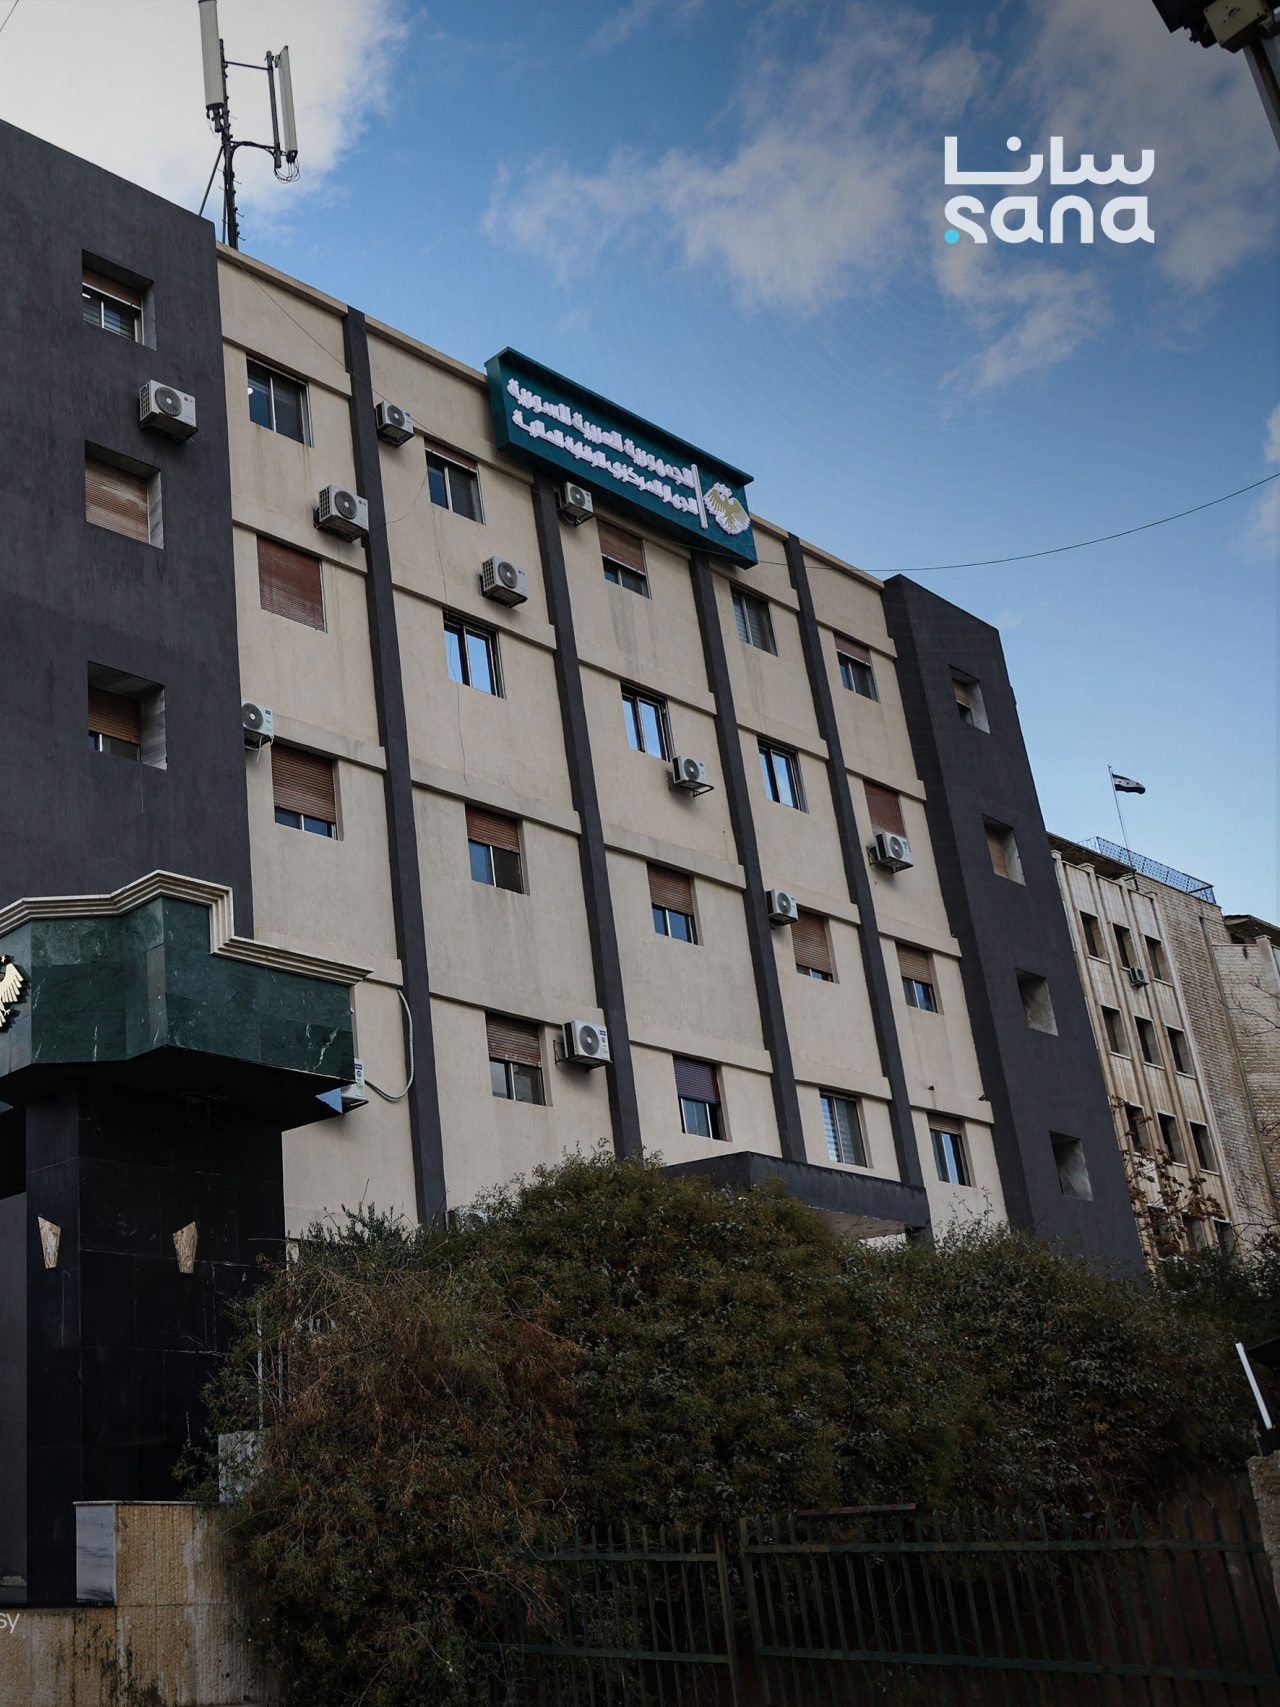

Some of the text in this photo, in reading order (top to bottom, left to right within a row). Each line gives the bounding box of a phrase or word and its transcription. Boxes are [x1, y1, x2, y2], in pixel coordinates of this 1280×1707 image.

[507, 378, 696, 489] الجمهورية العربية السورية
[512, 409, 565, 449] المالية
[564, 434, 606, 468] للرقابة
[606, 460, 665, 498] المركزي
